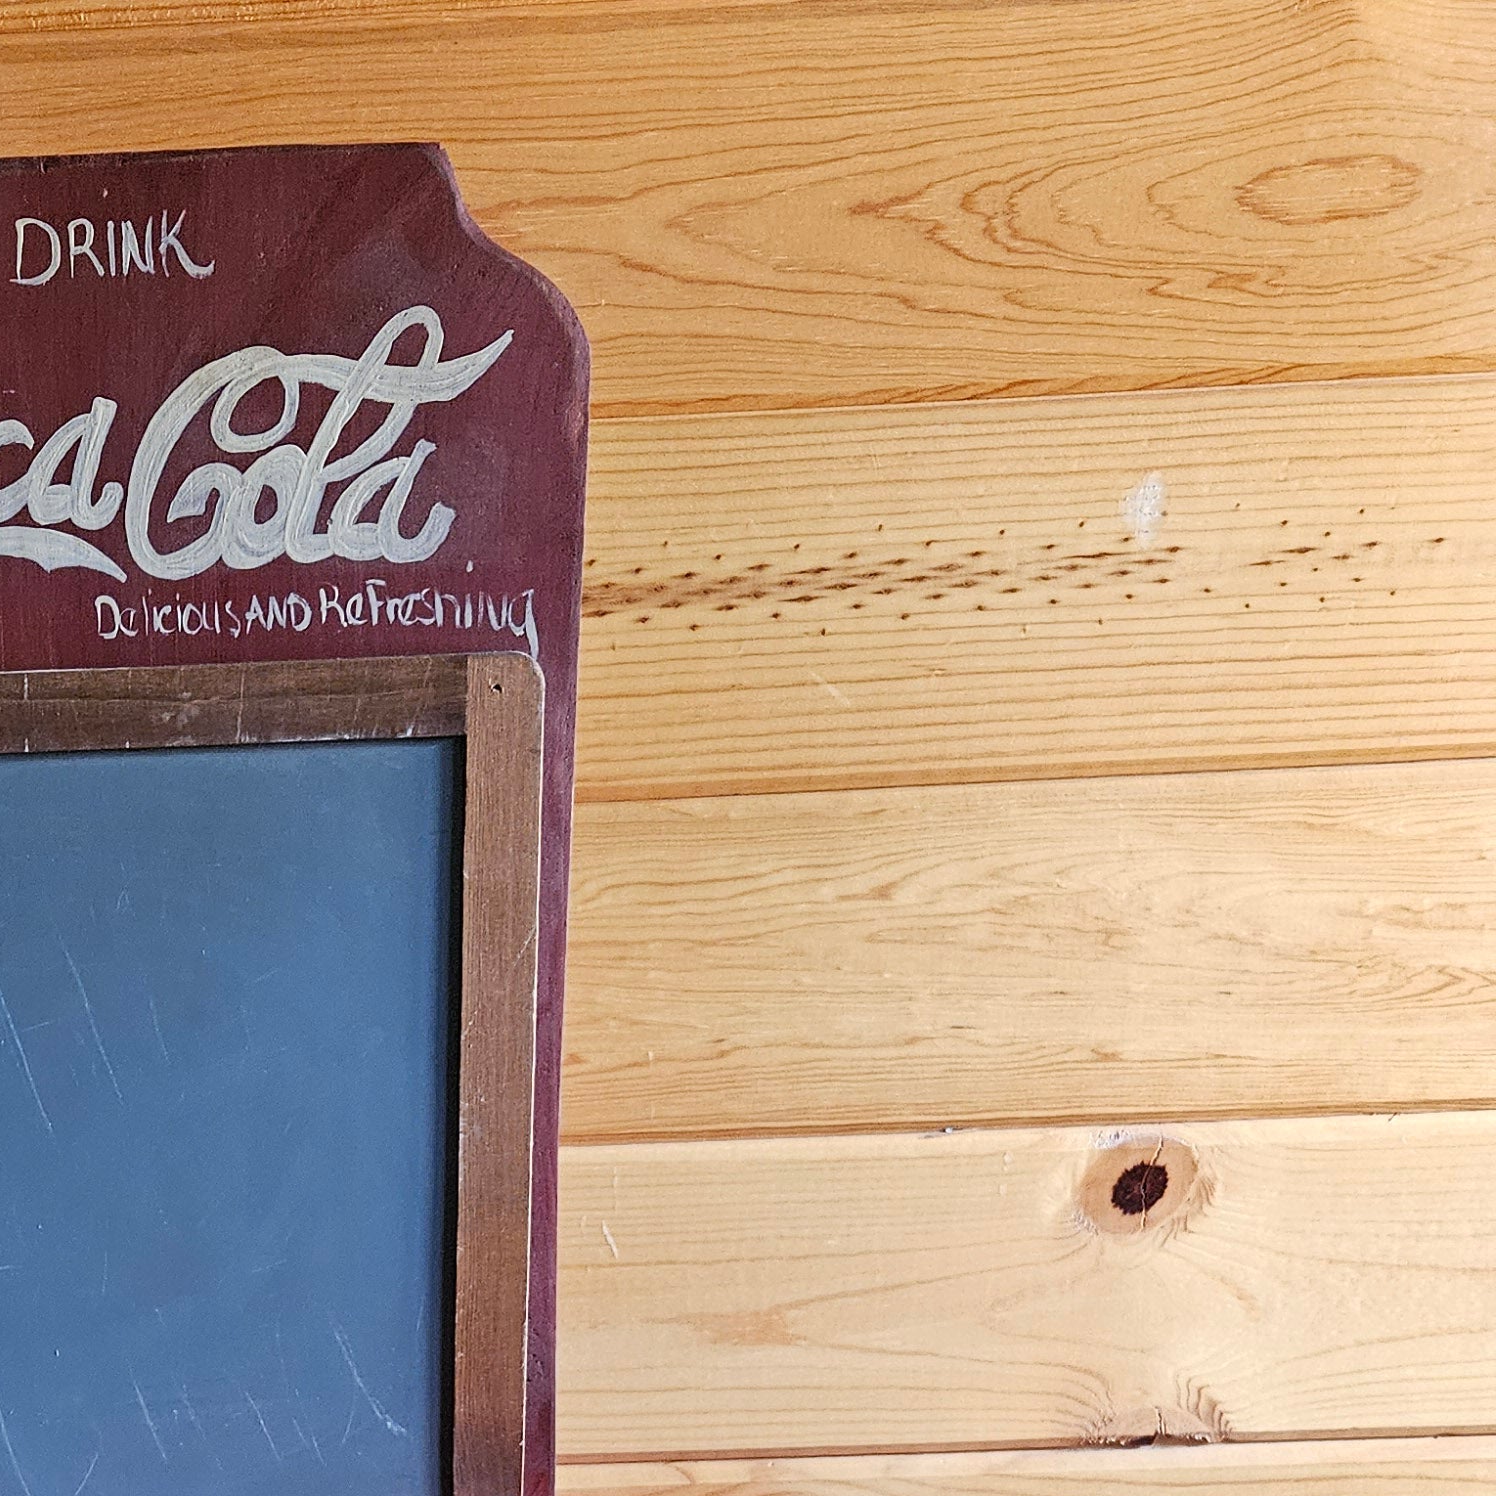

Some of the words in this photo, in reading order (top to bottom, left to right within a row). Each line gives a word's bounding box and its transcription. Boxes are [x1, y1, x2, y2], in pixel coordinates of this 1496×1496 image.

[10, 207, 215, 287] DRINK
[124, 304, 516, 581] Cola
[243, 592, 313, 632] AND
